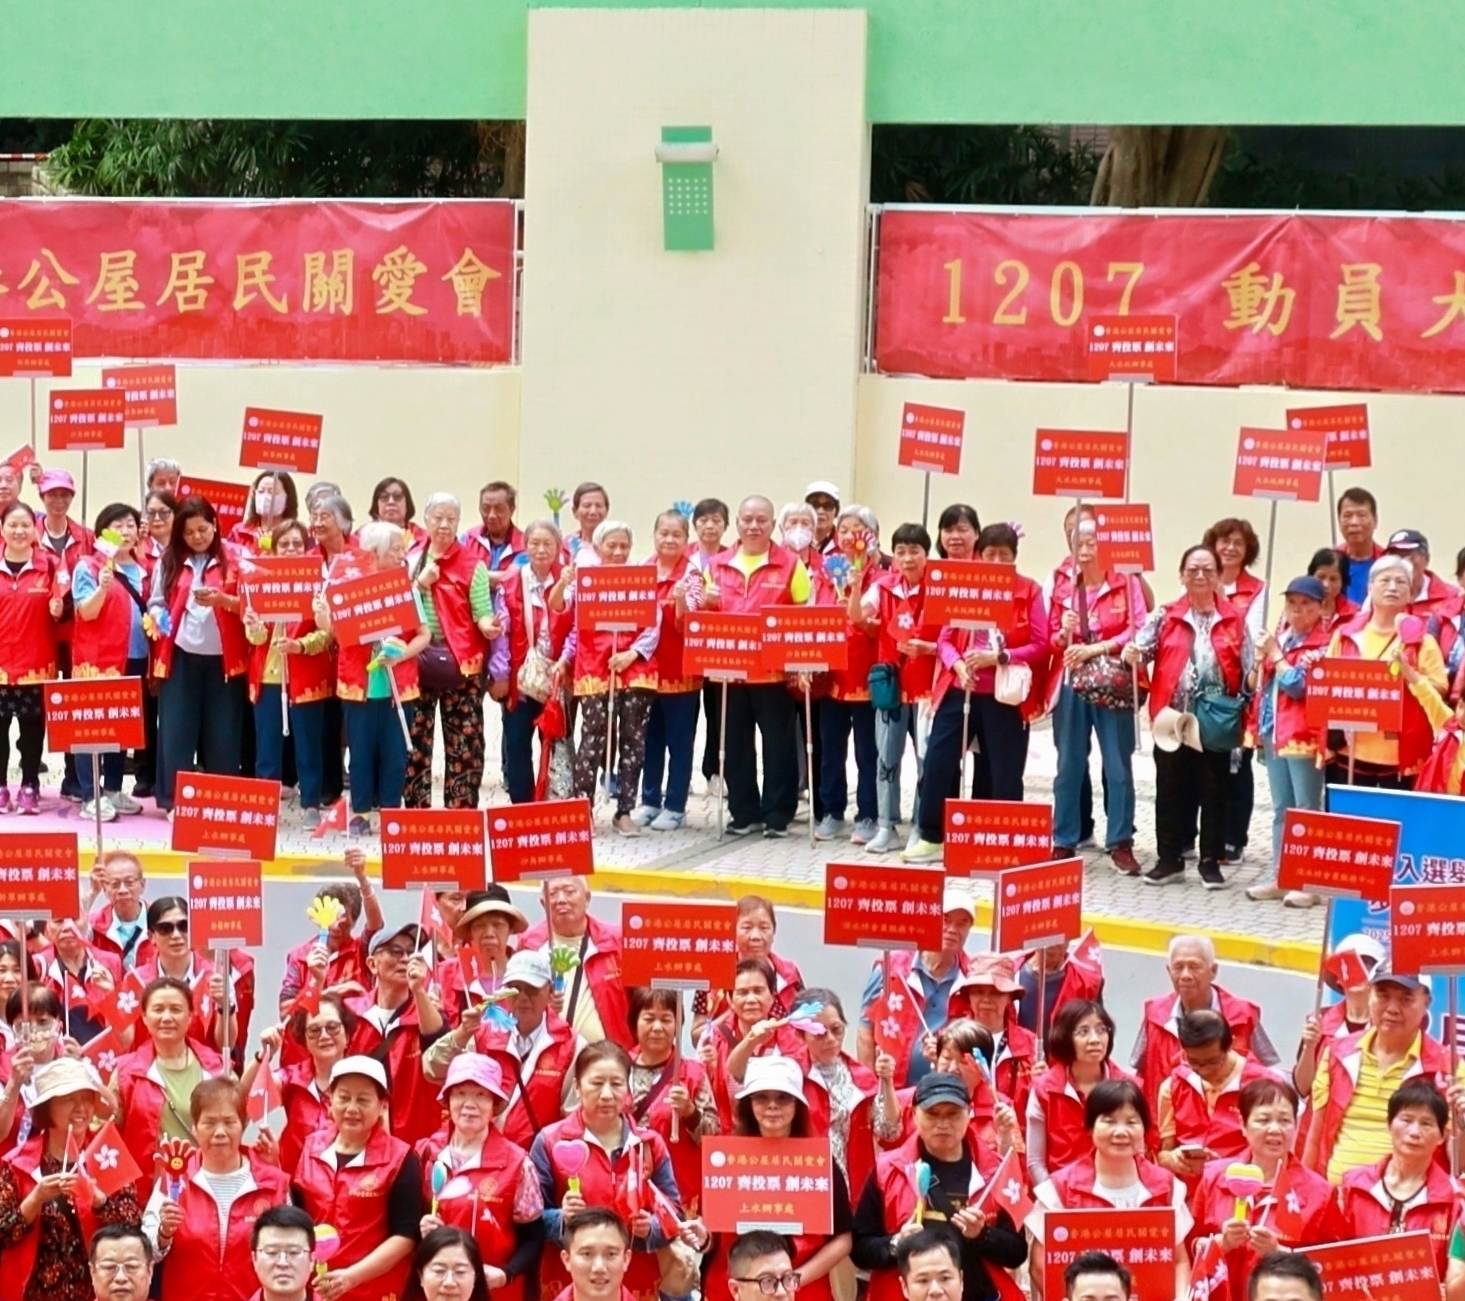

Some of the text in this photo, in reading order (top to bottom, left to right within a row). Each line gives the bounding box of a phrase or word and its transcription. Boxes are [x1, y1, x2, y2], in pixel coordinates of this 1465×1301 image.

[942, 259, 1145, 326] 1207
[1035, 456, 1123, 469] 1207 齊投票 創未來
[383, 841, 482, 855] 1207 齊投票 創未來
[1283, 842, 1393, 867] 1207 齊投票 創未來
[37, 867, 75, 881] 創未來
[726, 1153, 825, 1166] 香港公屋居民關愛會
[704, 1175, 831, 1191] 1207 齊投票 創未來
[740, 1202, 793, 1214] 上水辦事處
